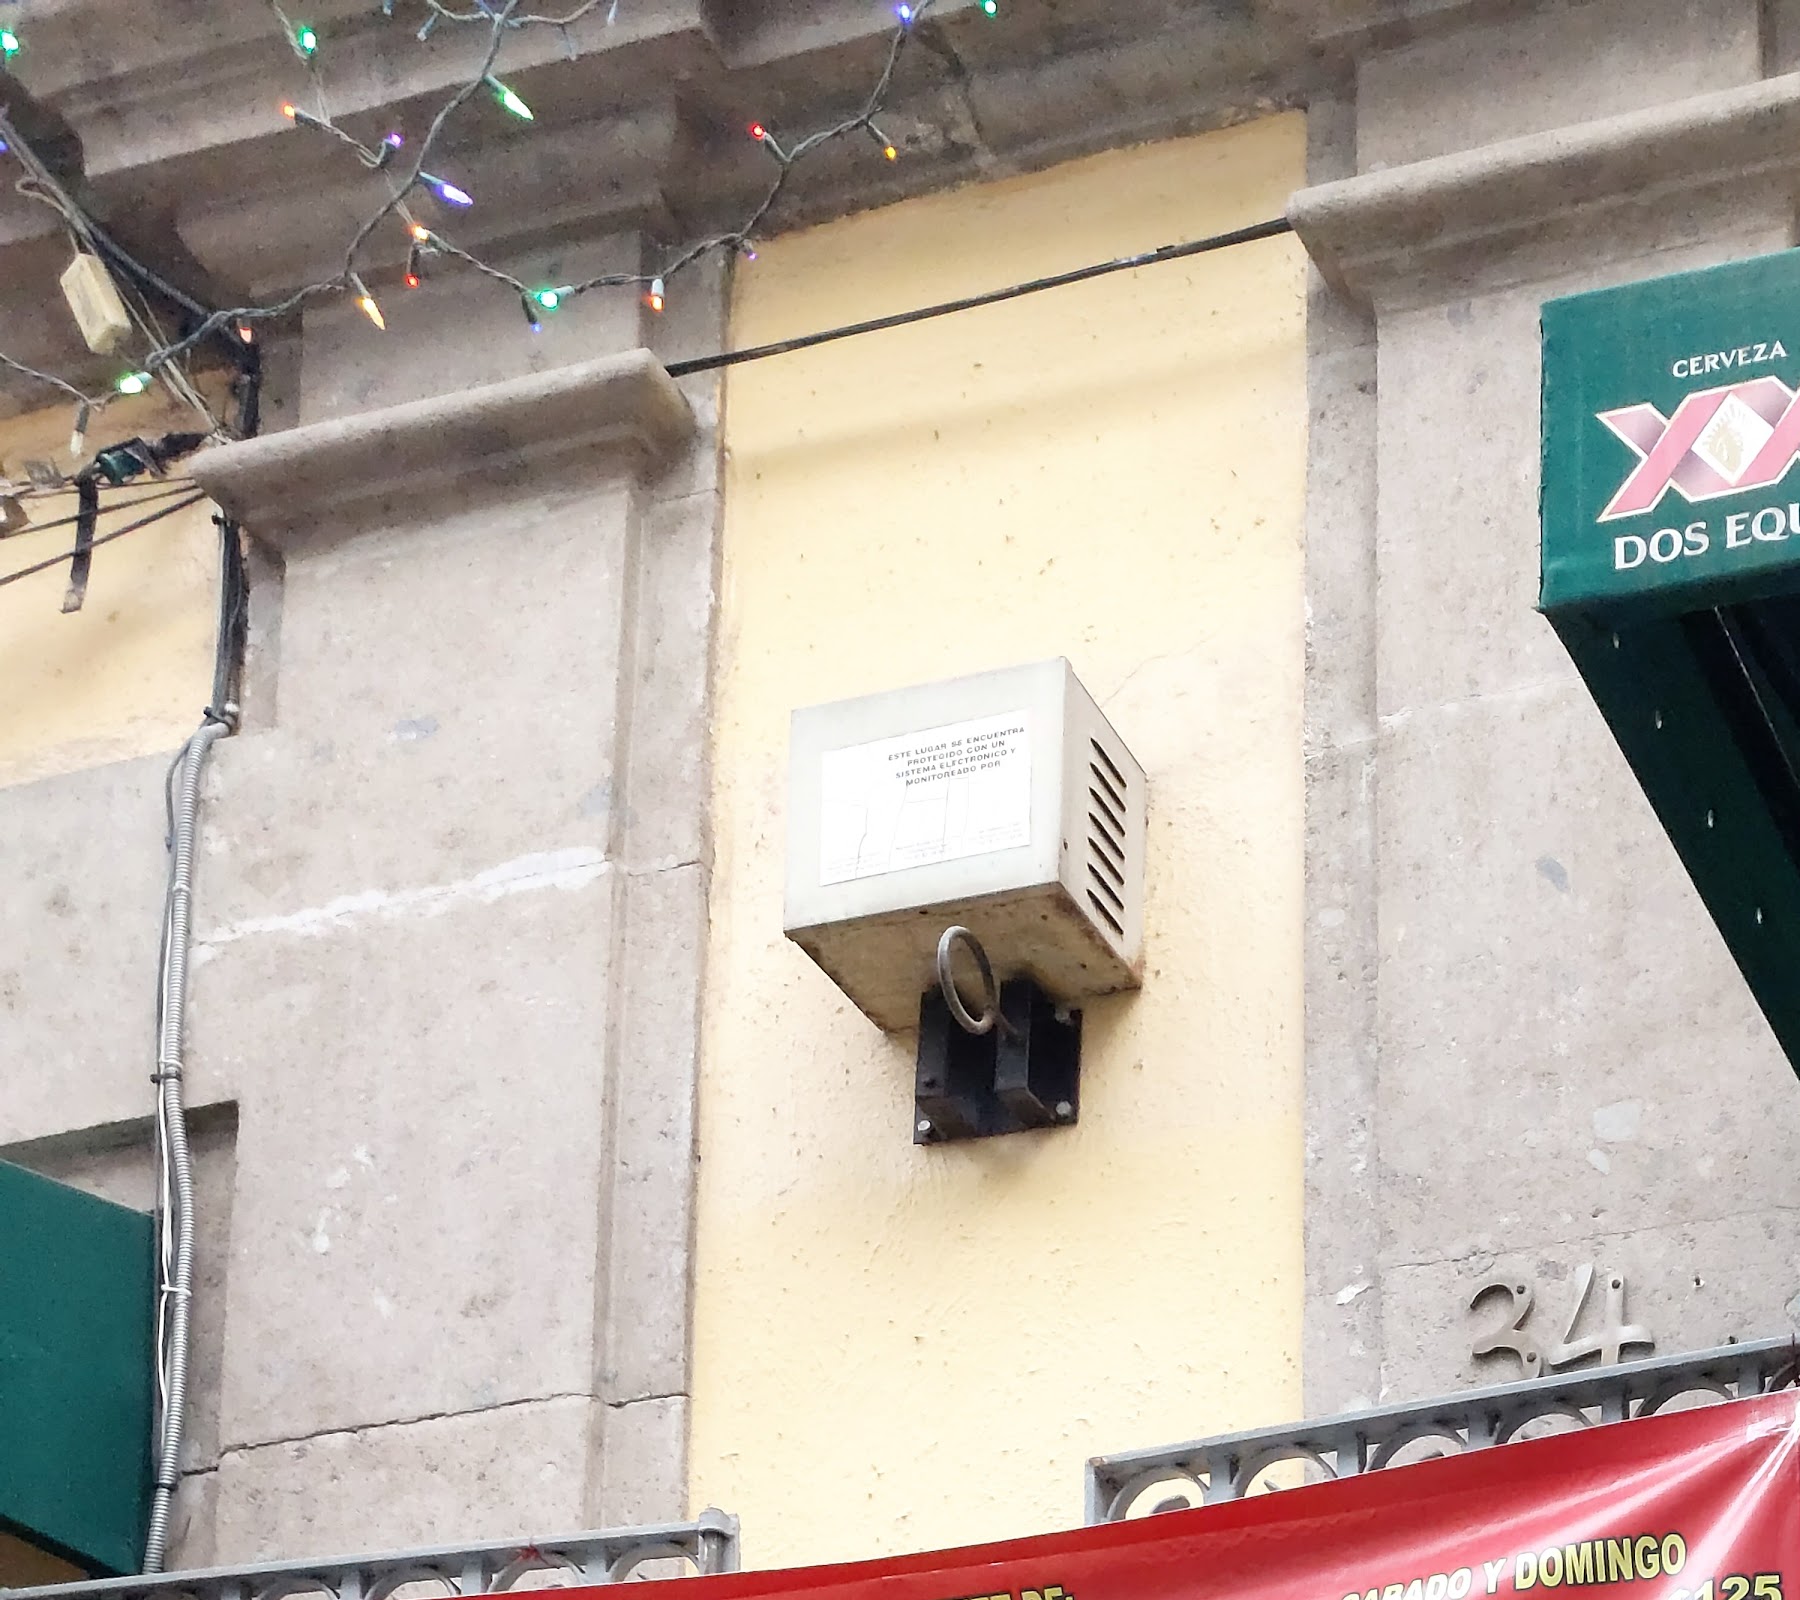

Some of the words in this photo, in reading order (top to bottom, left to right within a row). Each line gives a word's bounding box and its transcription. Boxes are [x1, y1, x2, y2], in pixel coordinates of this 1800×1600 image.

[1672, 340, 1788, 378] CERVEZA
[1614, 521, 1710, 570] DOS
[888, 751, 911, 761] ESTE
[915, 743, 946, 755] LUGAR
[967, 727, 1024, 744] ENCUENTRA
[908, 750, 963, 766] PROTEGIDO
[966, 744, 988, 754] CON
[991, 740, 1005, 748] UN
[896, 765, 936, 778] SISTEMA
[940, 750, 1007, 769] ELECTRONICO
[906, 766, 976, 786] MONITOREADO
[981, 760, 1000, 770] POR
[1484, 1557, 1506, 1594] Y
[1514, 1532, 1687, 1590] DOMINGO
